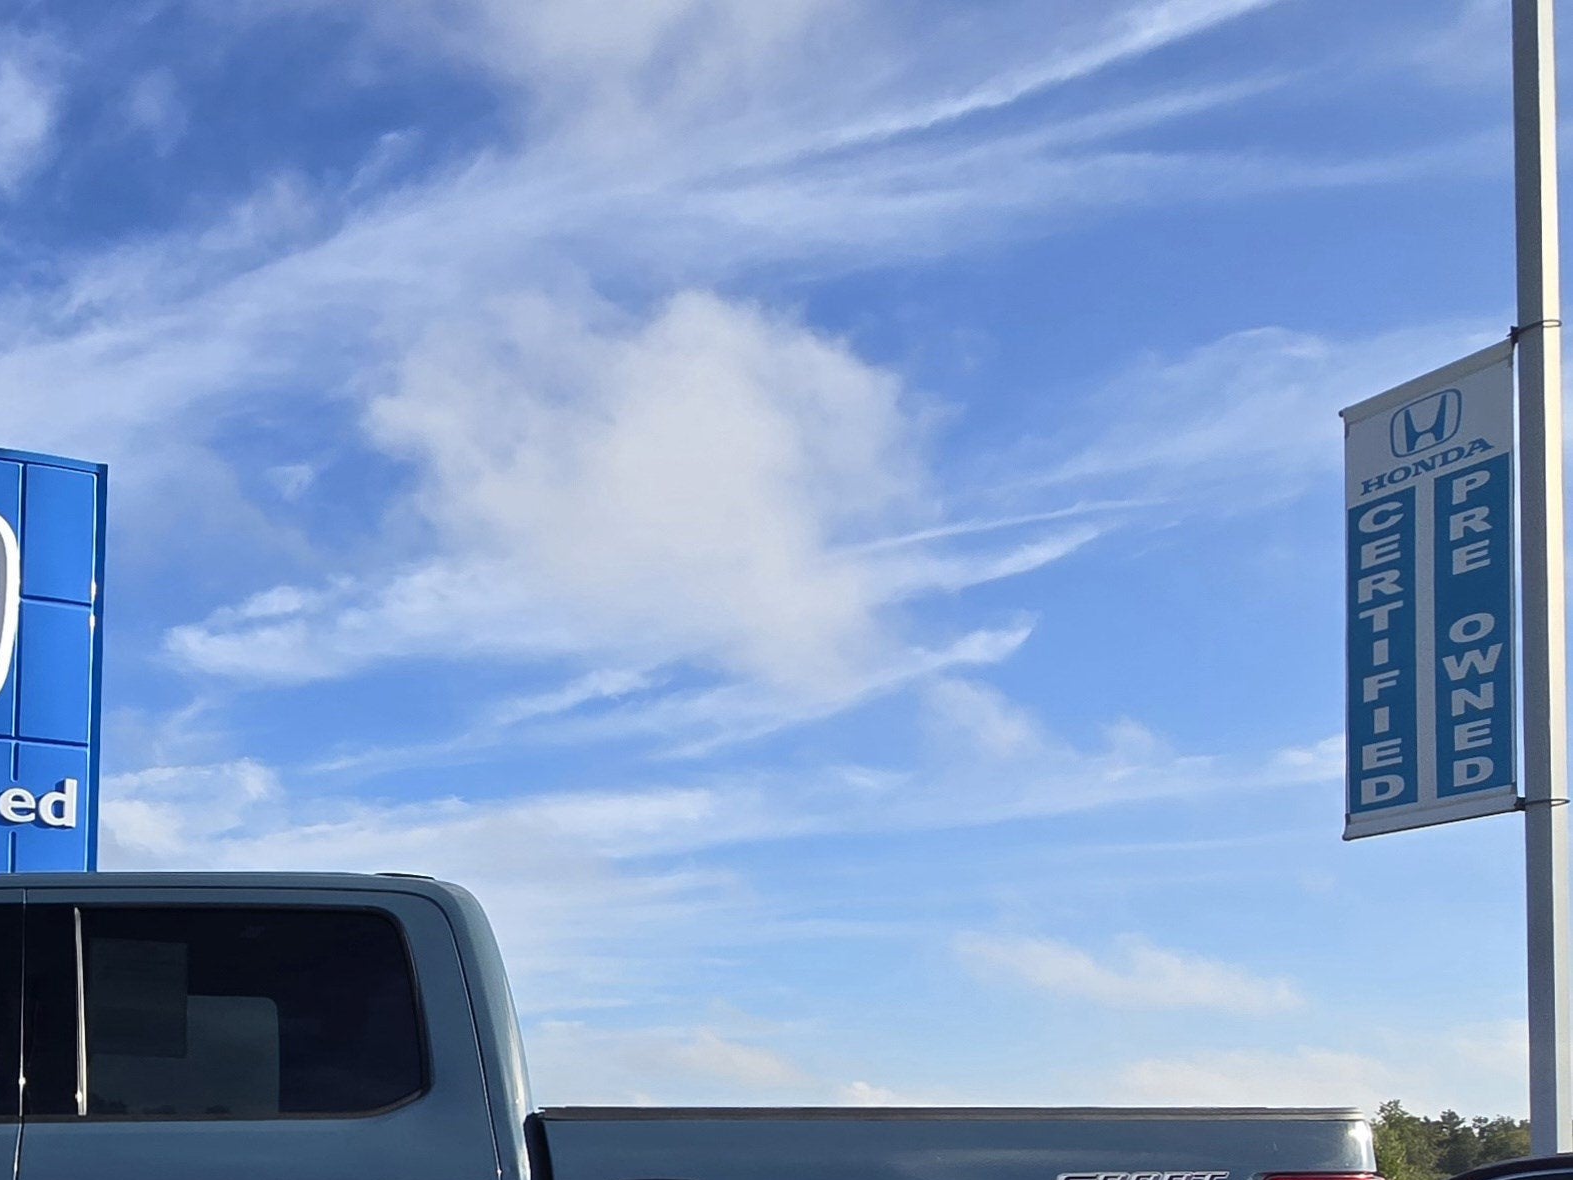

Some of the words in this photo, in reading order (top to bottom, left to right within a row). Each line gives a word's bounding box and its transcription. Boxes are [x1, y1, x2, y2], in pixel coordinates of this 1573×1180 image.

[1360, 437, 1494, 496] HONDA
[1449, 470, 1493, 576] PRE
[1357, 501, 1405, 806] CERTIFIED
[1442, 612, 1503, 787] OWNED
